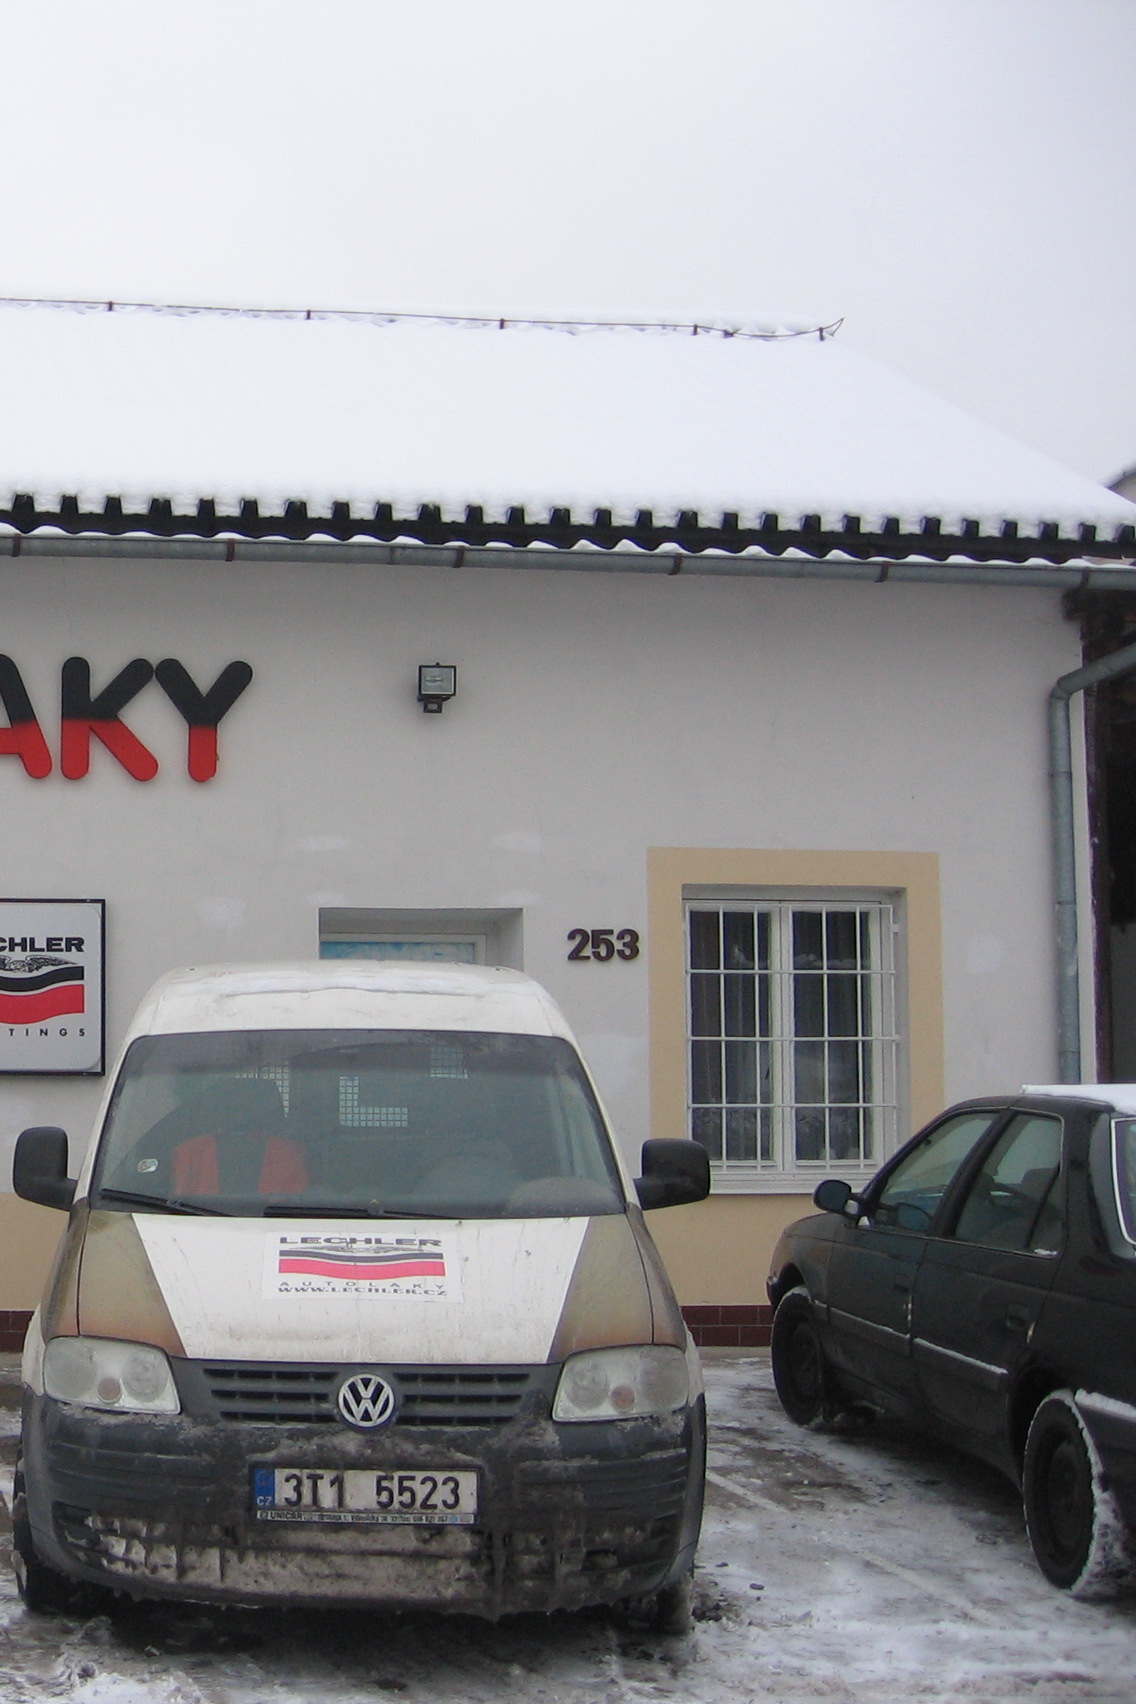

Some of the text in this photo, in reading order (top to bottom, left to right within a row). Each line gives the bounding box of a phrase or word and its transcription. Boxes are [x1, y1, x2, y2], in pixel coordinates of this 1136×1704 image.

[567, 928, 640, 961] 253
[279, 1237, 442, 1246] LECHLER
[279, 1281, 444, 1289] AUTOLAKY
[278, 1287, 447, 1296] WWW.LECHLER.CZ
[284, 1473, 460, 1509] 3T1 5523
[256, 1497, 271, 1506] CZ
